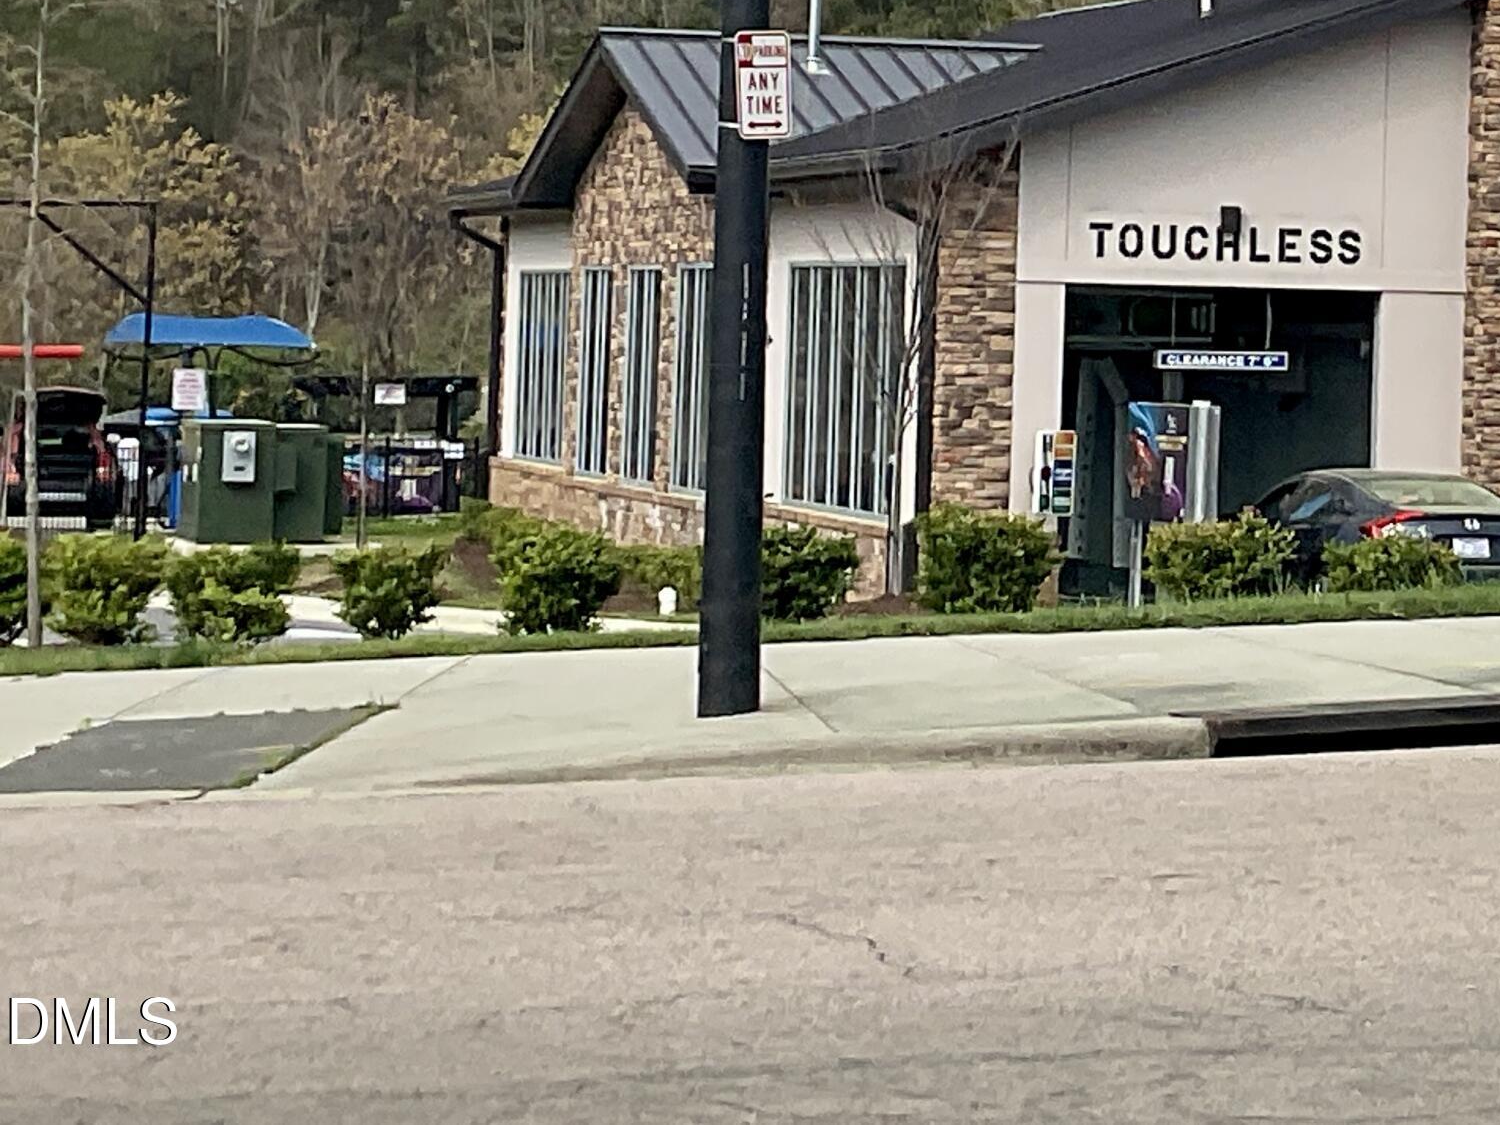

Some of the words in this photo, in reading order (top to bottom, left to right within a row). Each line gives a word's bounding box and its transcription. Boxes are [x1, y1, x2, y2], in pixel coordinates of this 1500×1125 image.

[748, 72, 779, 91] ANY
[746, 95, 784, 114] TIME
[1089, 222, 1361, 265] TOUCHLESS
[1166, 355, 1244, 367] CLEARANCE
